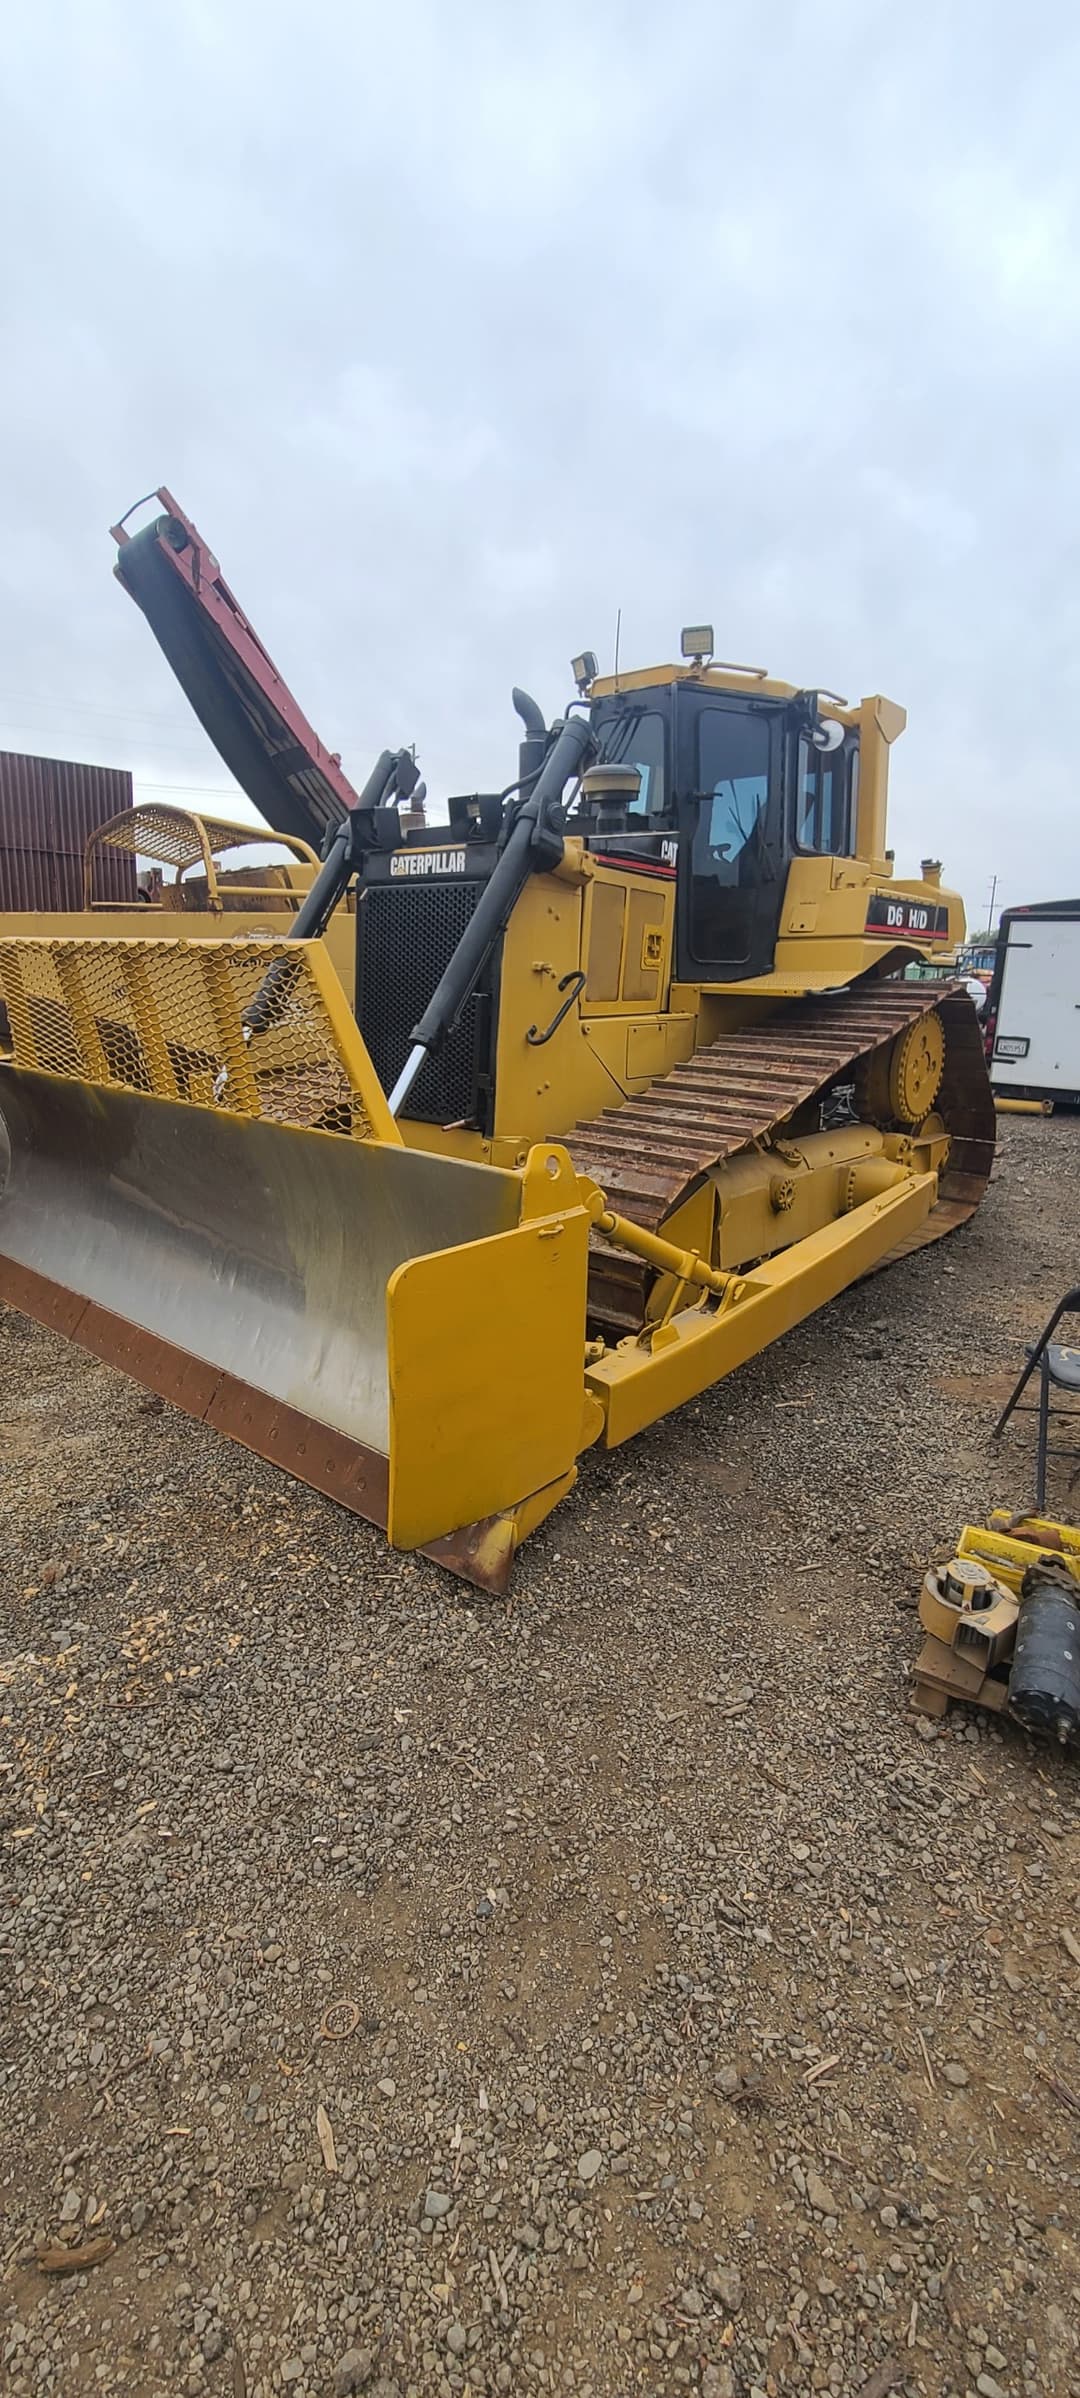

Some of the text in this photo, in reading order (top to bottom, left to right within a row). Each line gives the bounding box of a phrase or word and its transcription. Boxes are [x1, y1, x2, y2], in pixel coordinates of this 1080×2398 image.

[390, 850, 466, 877] CATERPILLAR
[661, 839, 679, 868] CAT
[886, 905, 928, 930] D6 H/D
